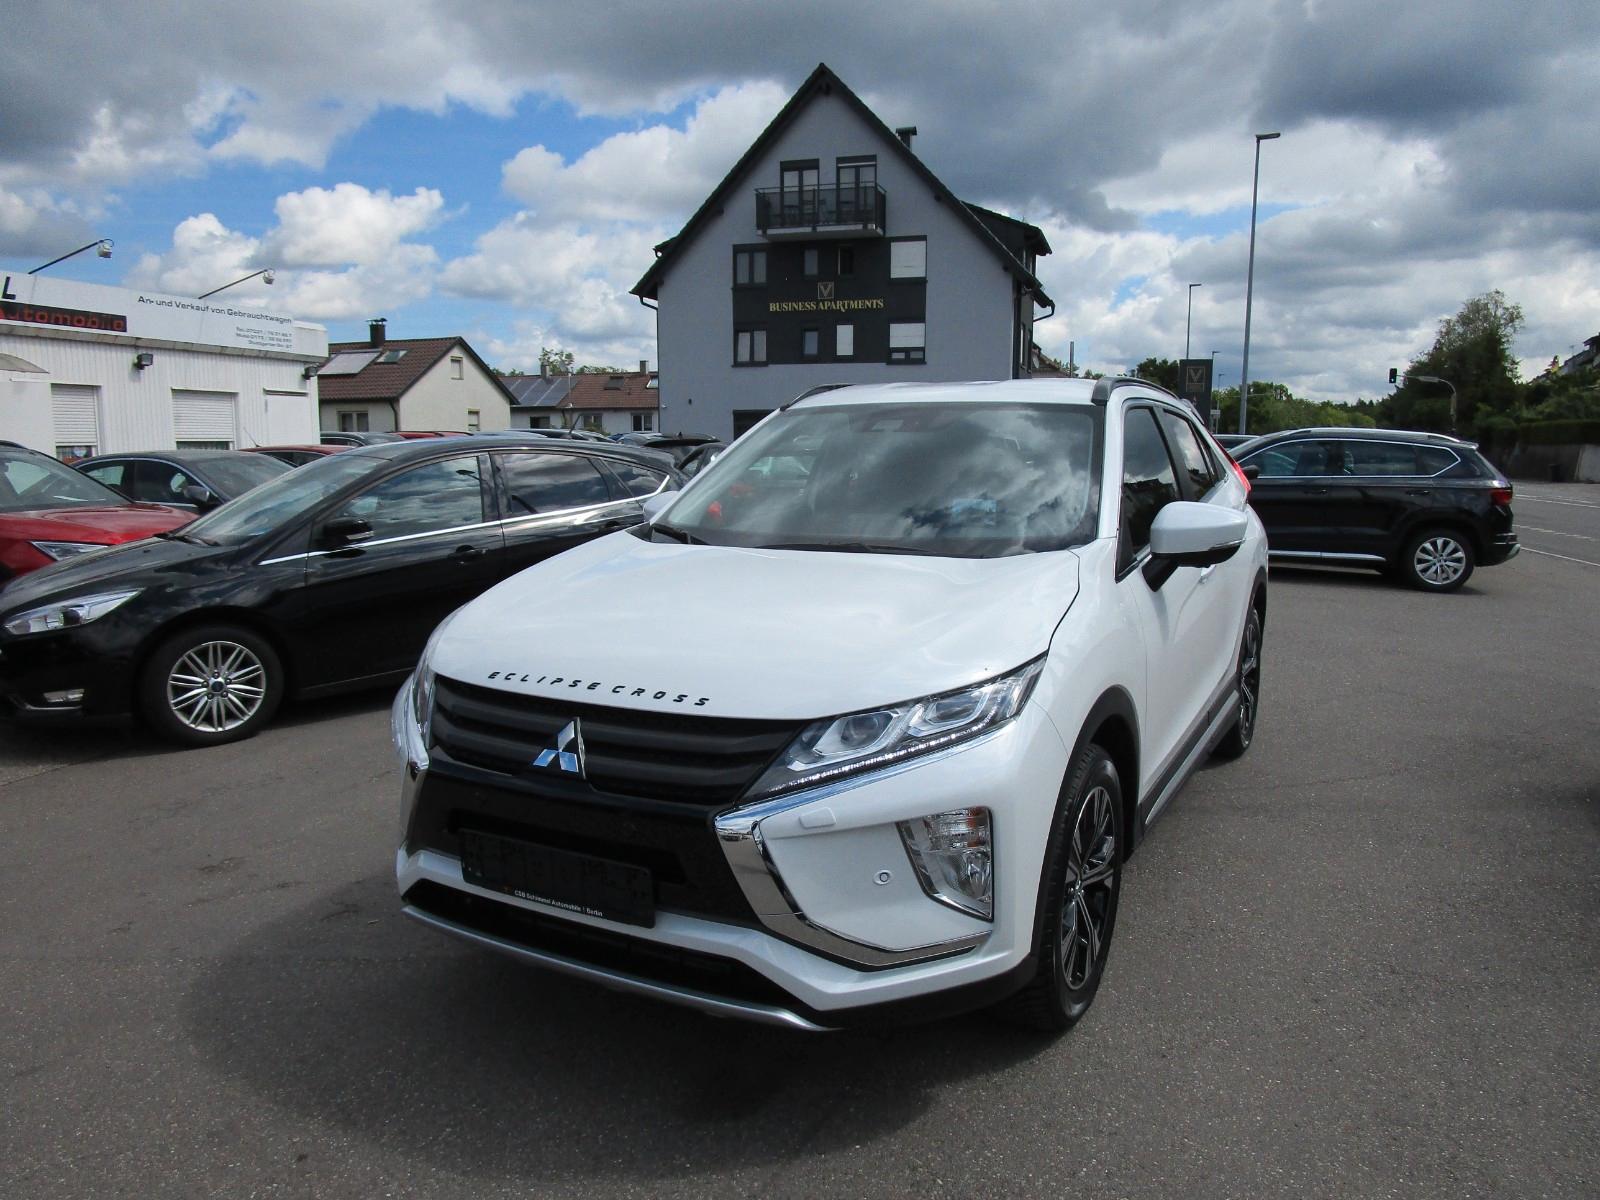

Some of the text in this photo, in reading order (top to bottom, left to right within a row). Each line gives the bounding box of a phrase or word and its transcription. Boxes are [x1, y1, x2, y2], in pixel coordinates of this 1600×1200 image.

[137, 295, 292, 325] An- und Verkauf von Gebrauchtwagen
[769, 299, 885, 313] BUSINESS APARTMENTS
[487, 671, 710, 706] ECLIPSE CROSS
[551, 899, 581, 911] Automobile
[586, 907, 603, 917] Berlin
